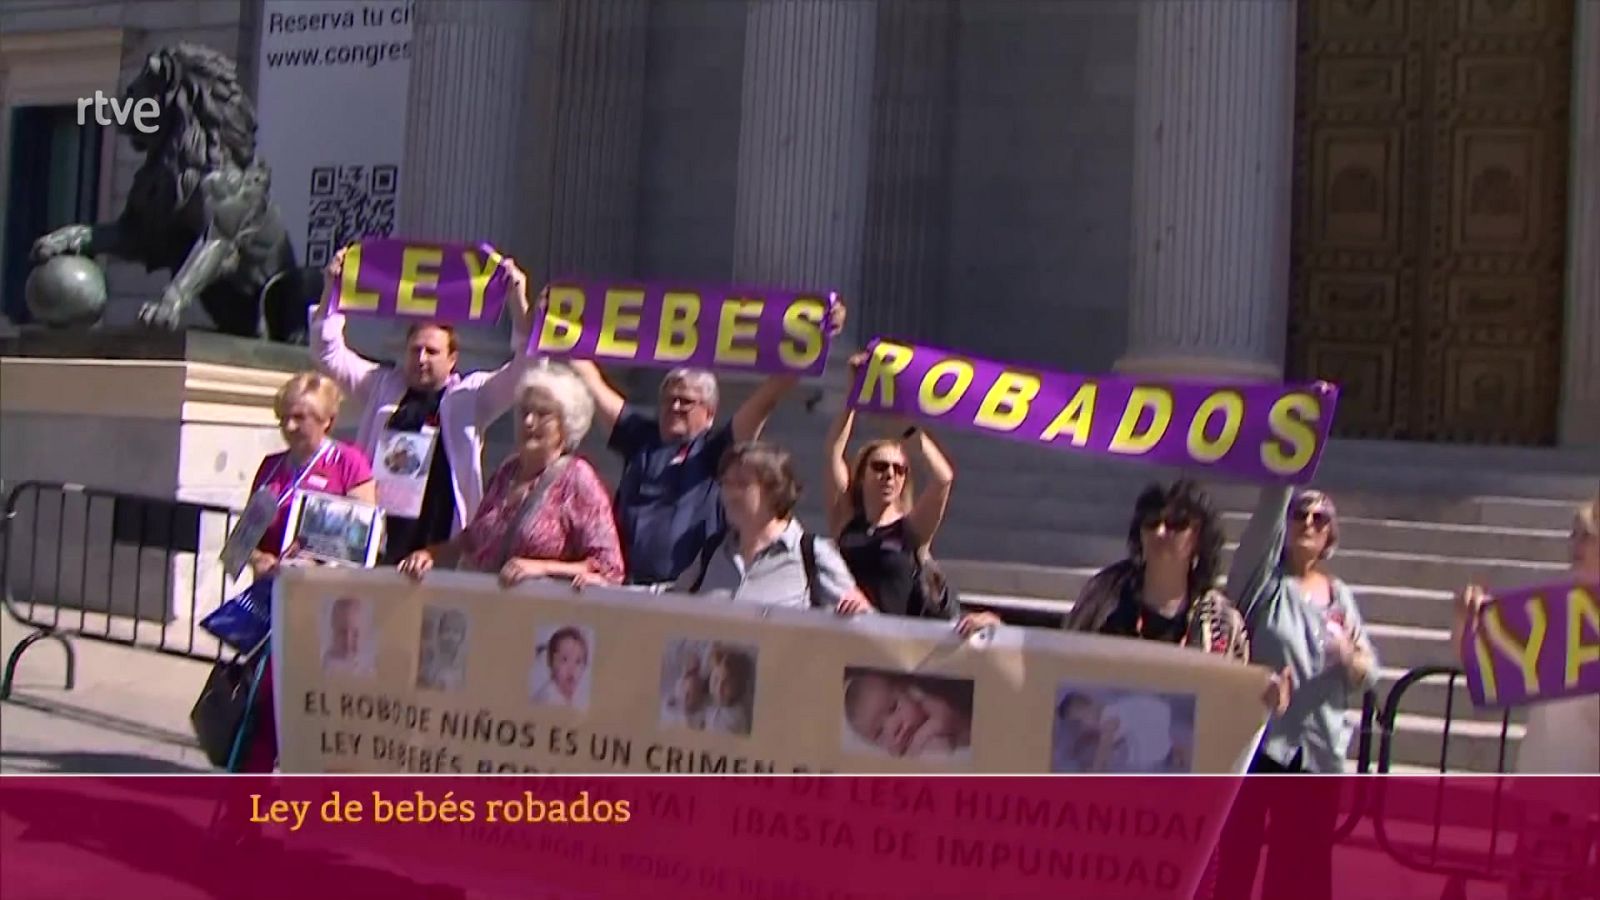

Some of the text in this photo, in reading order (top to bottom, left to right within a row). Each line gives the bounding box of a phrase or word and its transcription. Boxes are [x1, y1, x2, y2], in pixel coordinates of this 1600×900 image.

[269, 10, 355, 34] Reserva
[363, 6, 383, 27] tu
[340, 243, 502, 320] LEY
[857, 340, 1322, 475] ROBADOS
[304, 692, 331, 716] EL
[406, 704, 431, 732] DE
[440, 708, 536, 749] NIÑOS
[549, 726, 577, 756] ES
[593, 733, 632, 768] UN
[320, 732, 362, 755] LEY
[936, 835, 1183, 892] IMPUNIDAD
